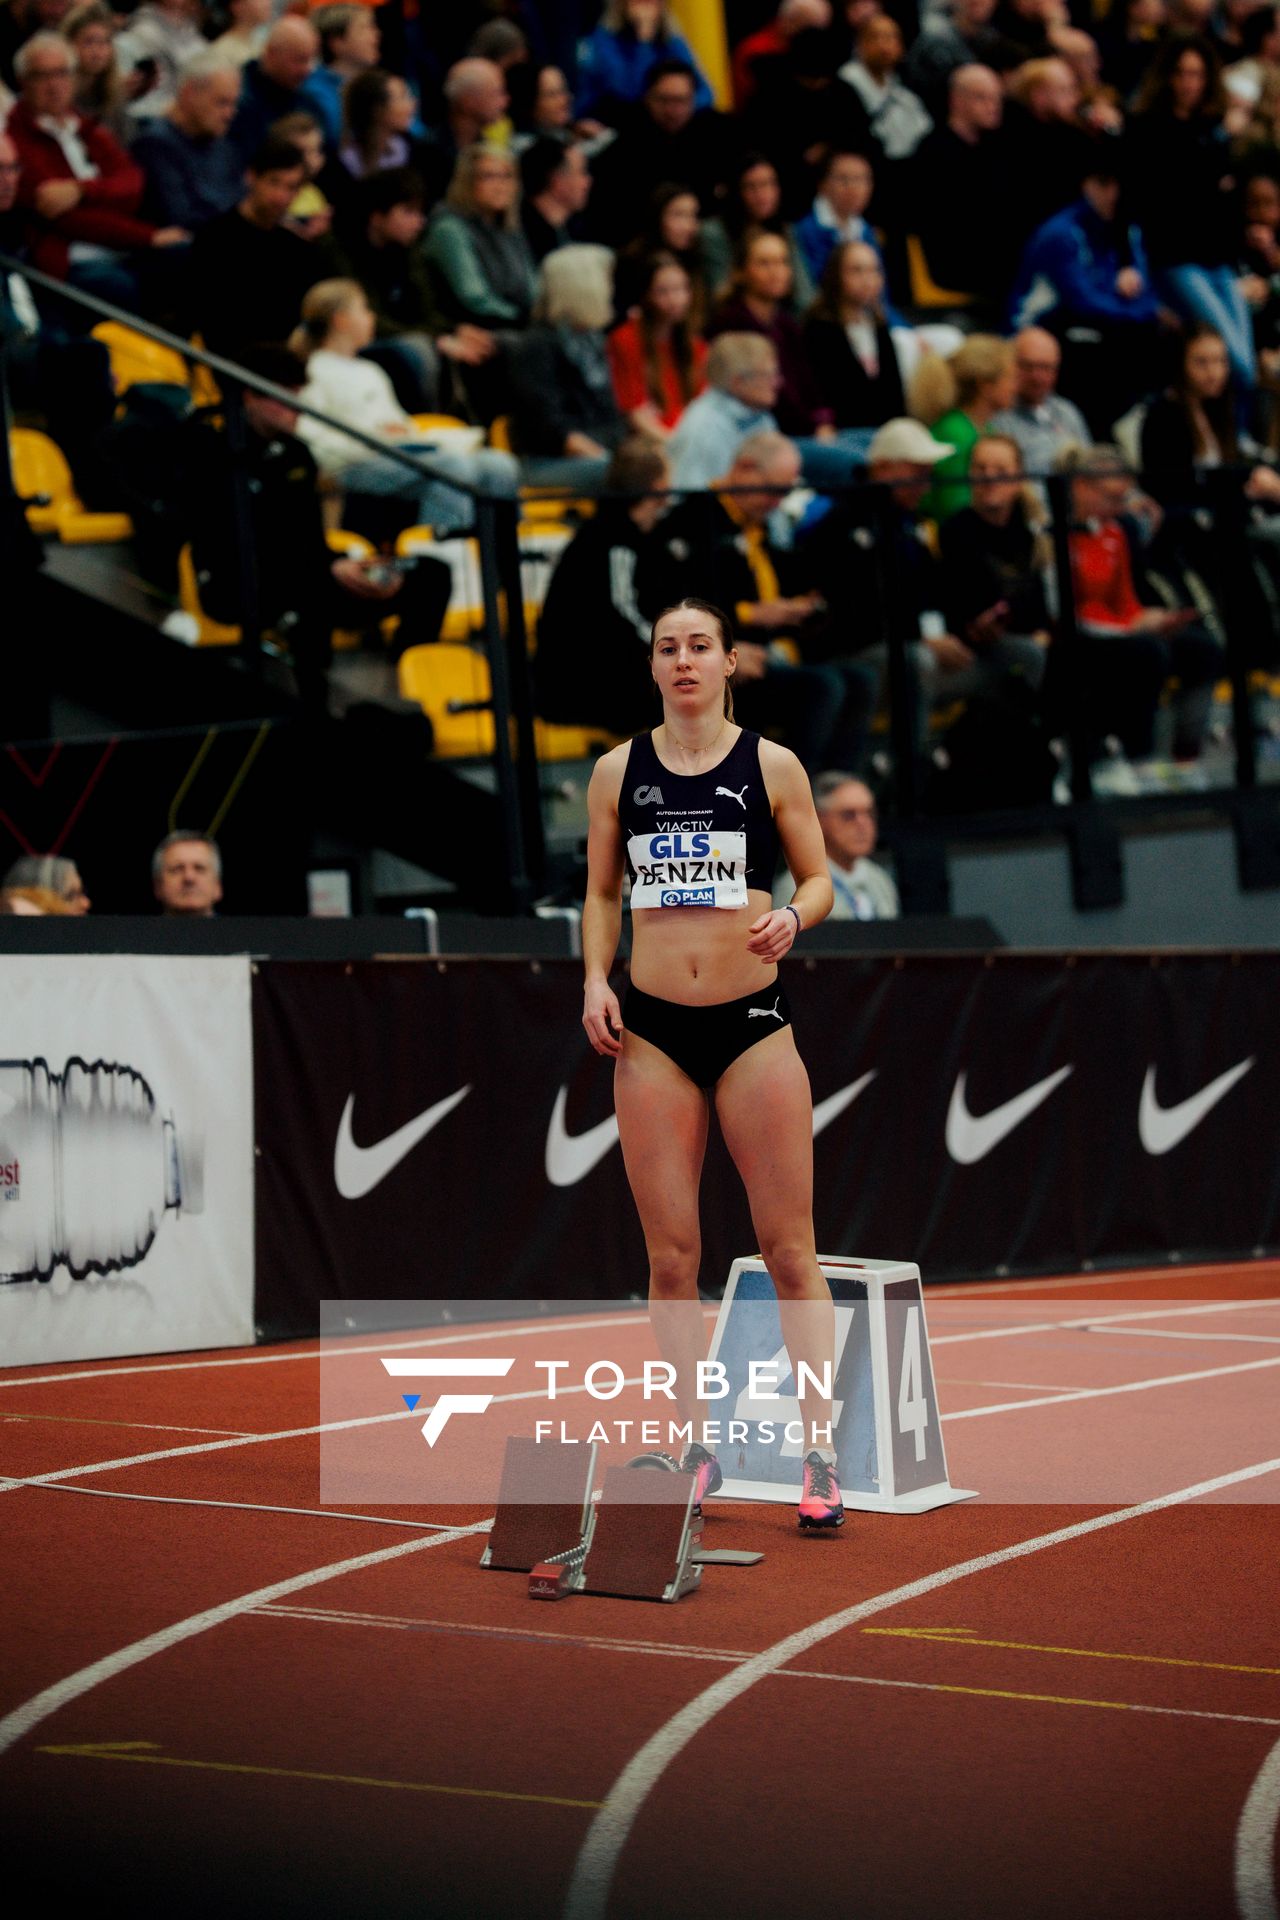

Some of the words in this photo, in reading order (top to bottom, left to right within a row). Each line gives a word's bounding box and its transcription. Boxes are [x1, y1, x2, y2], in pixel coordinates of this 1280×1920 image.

[656, 820, 713, 832] VIACTIV
[638, 861, 736, 886] BENZIN
[682, 891, 713, 901] PLAN
[898, 1306, 929, 1463] 4
[529, 1586, 556, 1595] OMEGA
